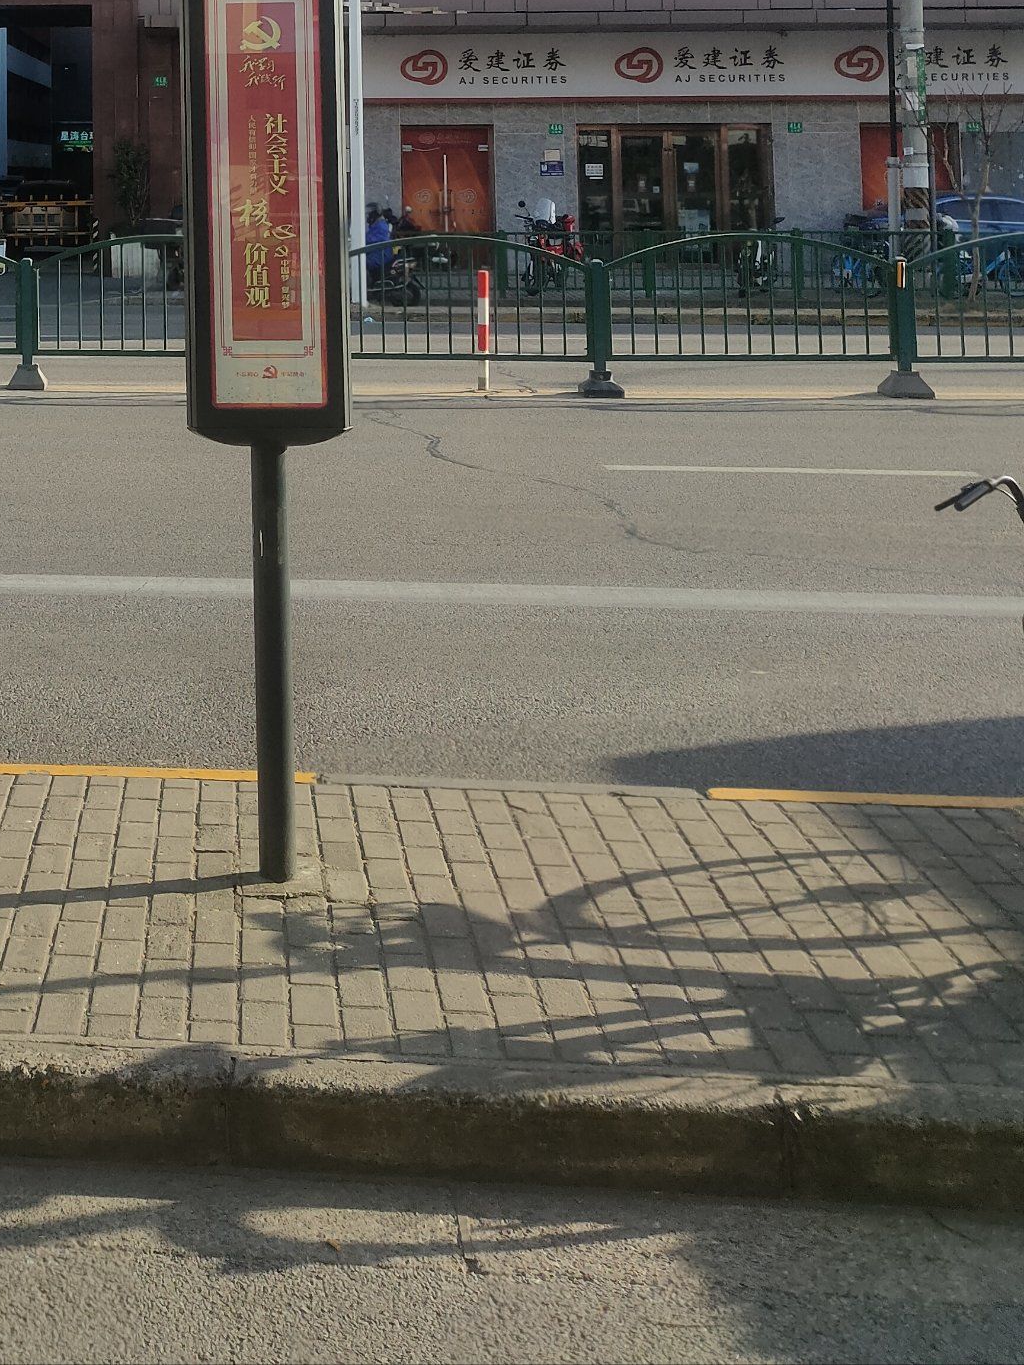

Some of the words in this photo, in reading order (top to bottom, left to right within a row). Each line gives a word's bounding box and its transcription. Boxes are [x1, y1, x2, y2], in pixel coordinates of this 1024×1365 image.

[458, 47, 567, 72] 爱建证券
[673, 45, 785, 70] 爱建证券
[458, 76, 475, 85] AJ
[482, 75, 568, 85] SECURITIES
[675, 74, 691, 83] AJ
[699, 73, 786, 83] SECURITIES
[264, 113, 289, 195] 社会主义
[233, 197, 296, 240] 核心
[243, 242, 271, 309] 价值观
[280, 259, 290, 282] 中国梦
